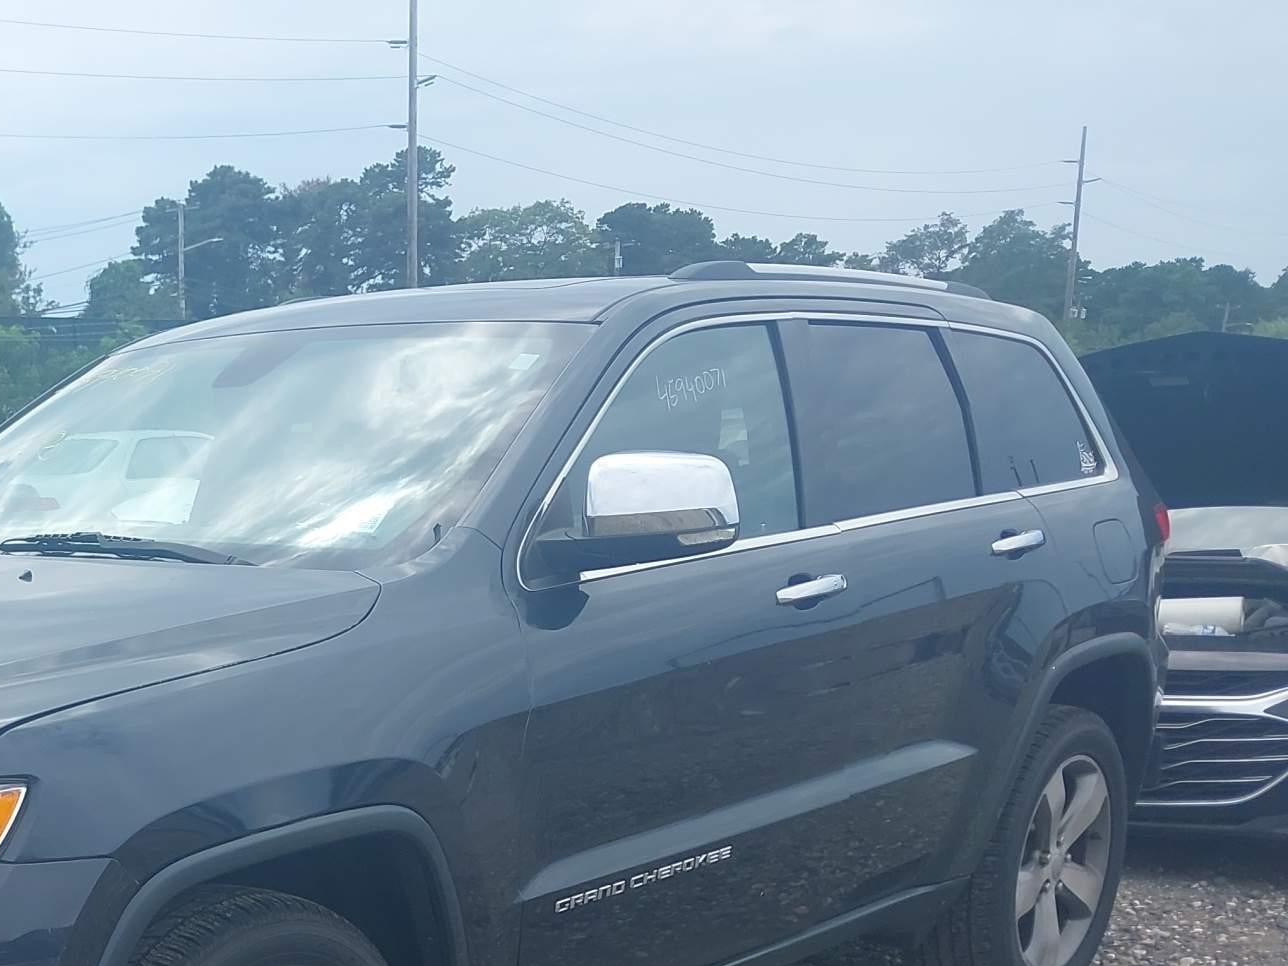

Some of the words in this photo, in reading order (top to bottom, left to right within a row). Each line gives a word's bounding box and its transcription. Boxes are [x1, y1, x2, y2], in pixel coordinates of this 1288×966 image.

[655, 367, 727, 410] 45940071
[554, 879, 627, 913] GRAND
[629, 845, 733, 889] CHEROKEE
